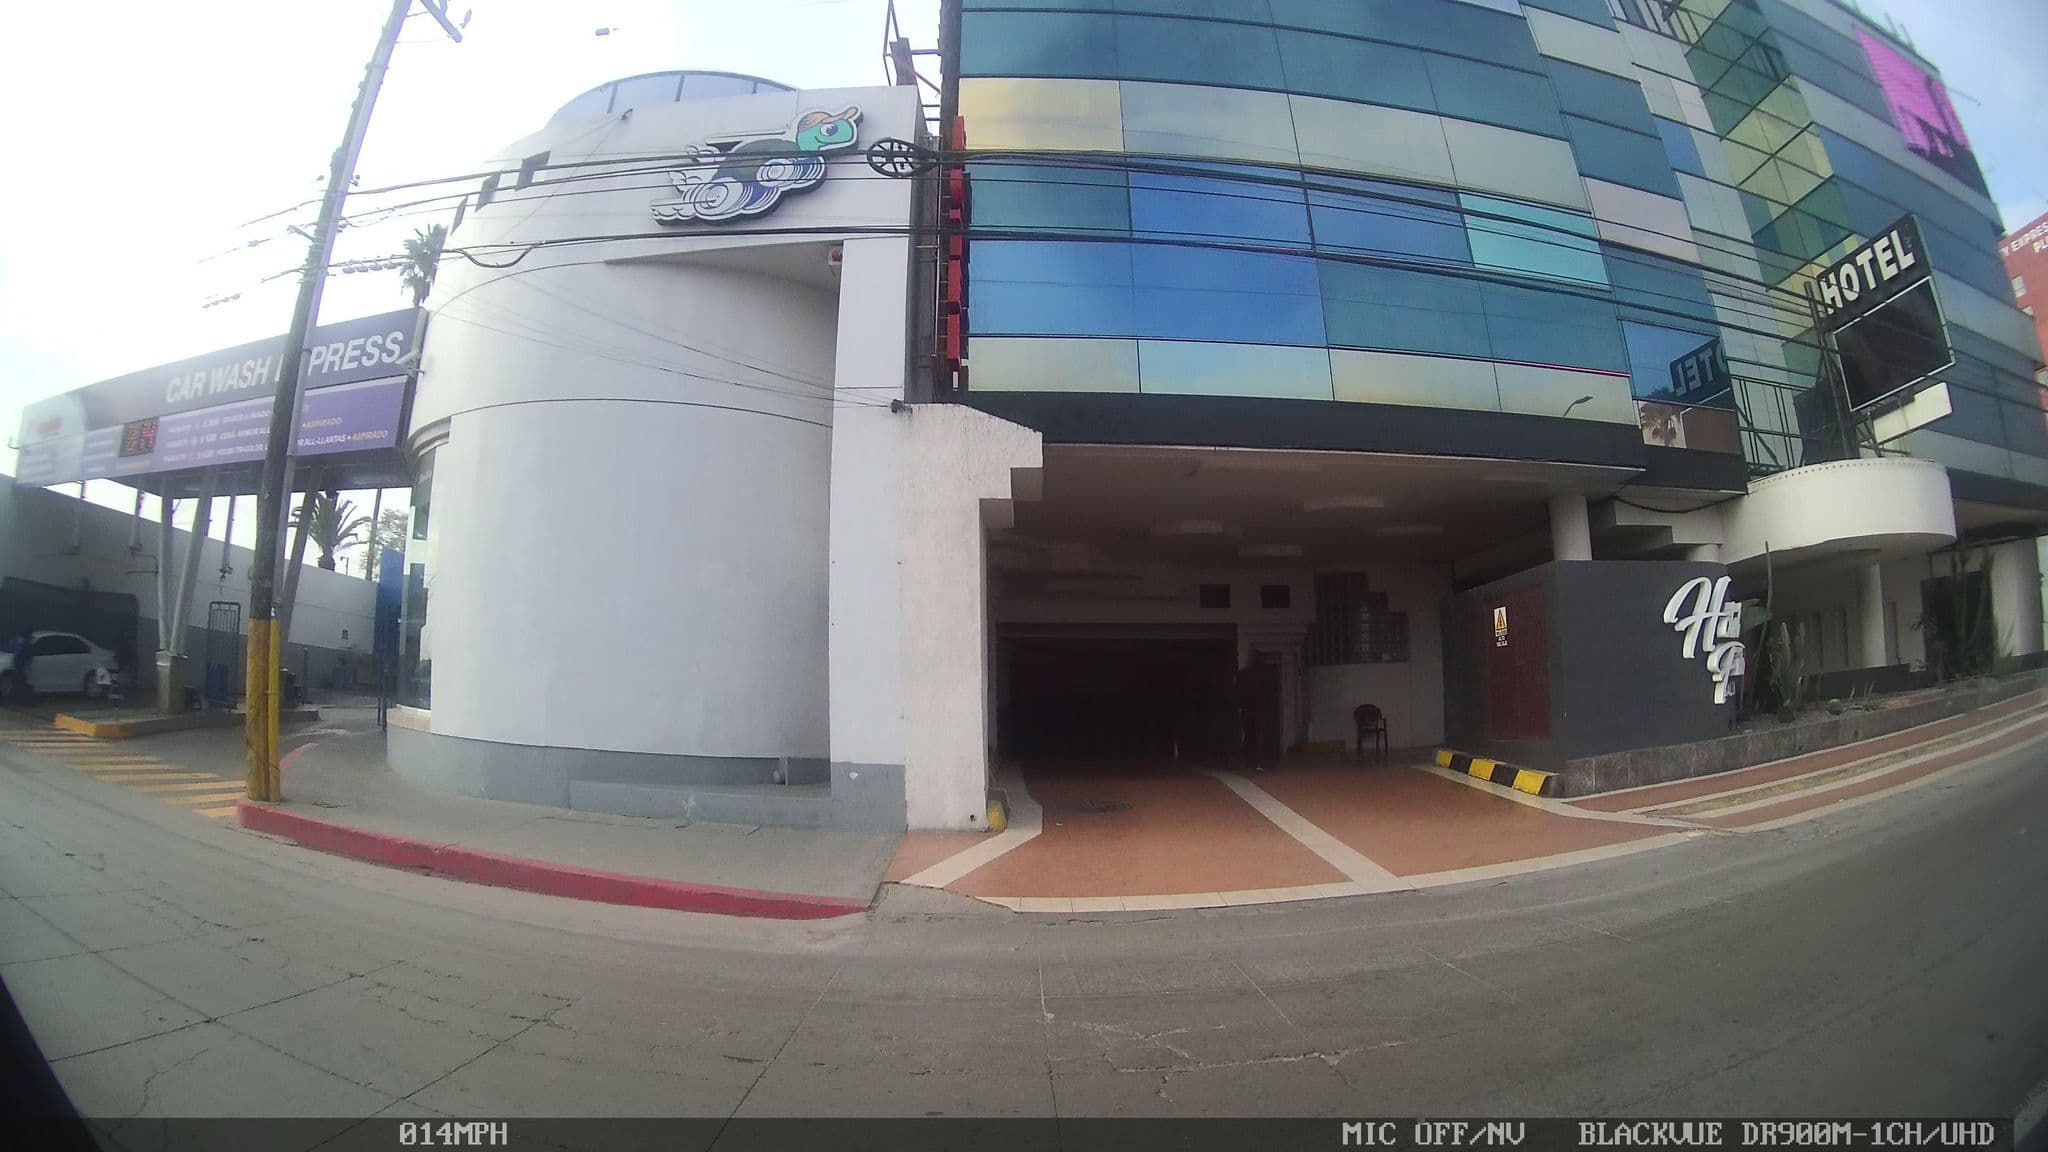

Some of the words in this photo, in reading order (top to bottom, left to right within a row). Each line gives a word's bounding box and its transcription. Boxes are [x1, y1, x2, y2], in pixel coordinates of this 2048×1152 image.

[1820, 229, 1915, 315] HOTEL
[166, 375, 203, 403] CAR
[209, 356, 272, 395] WASH
